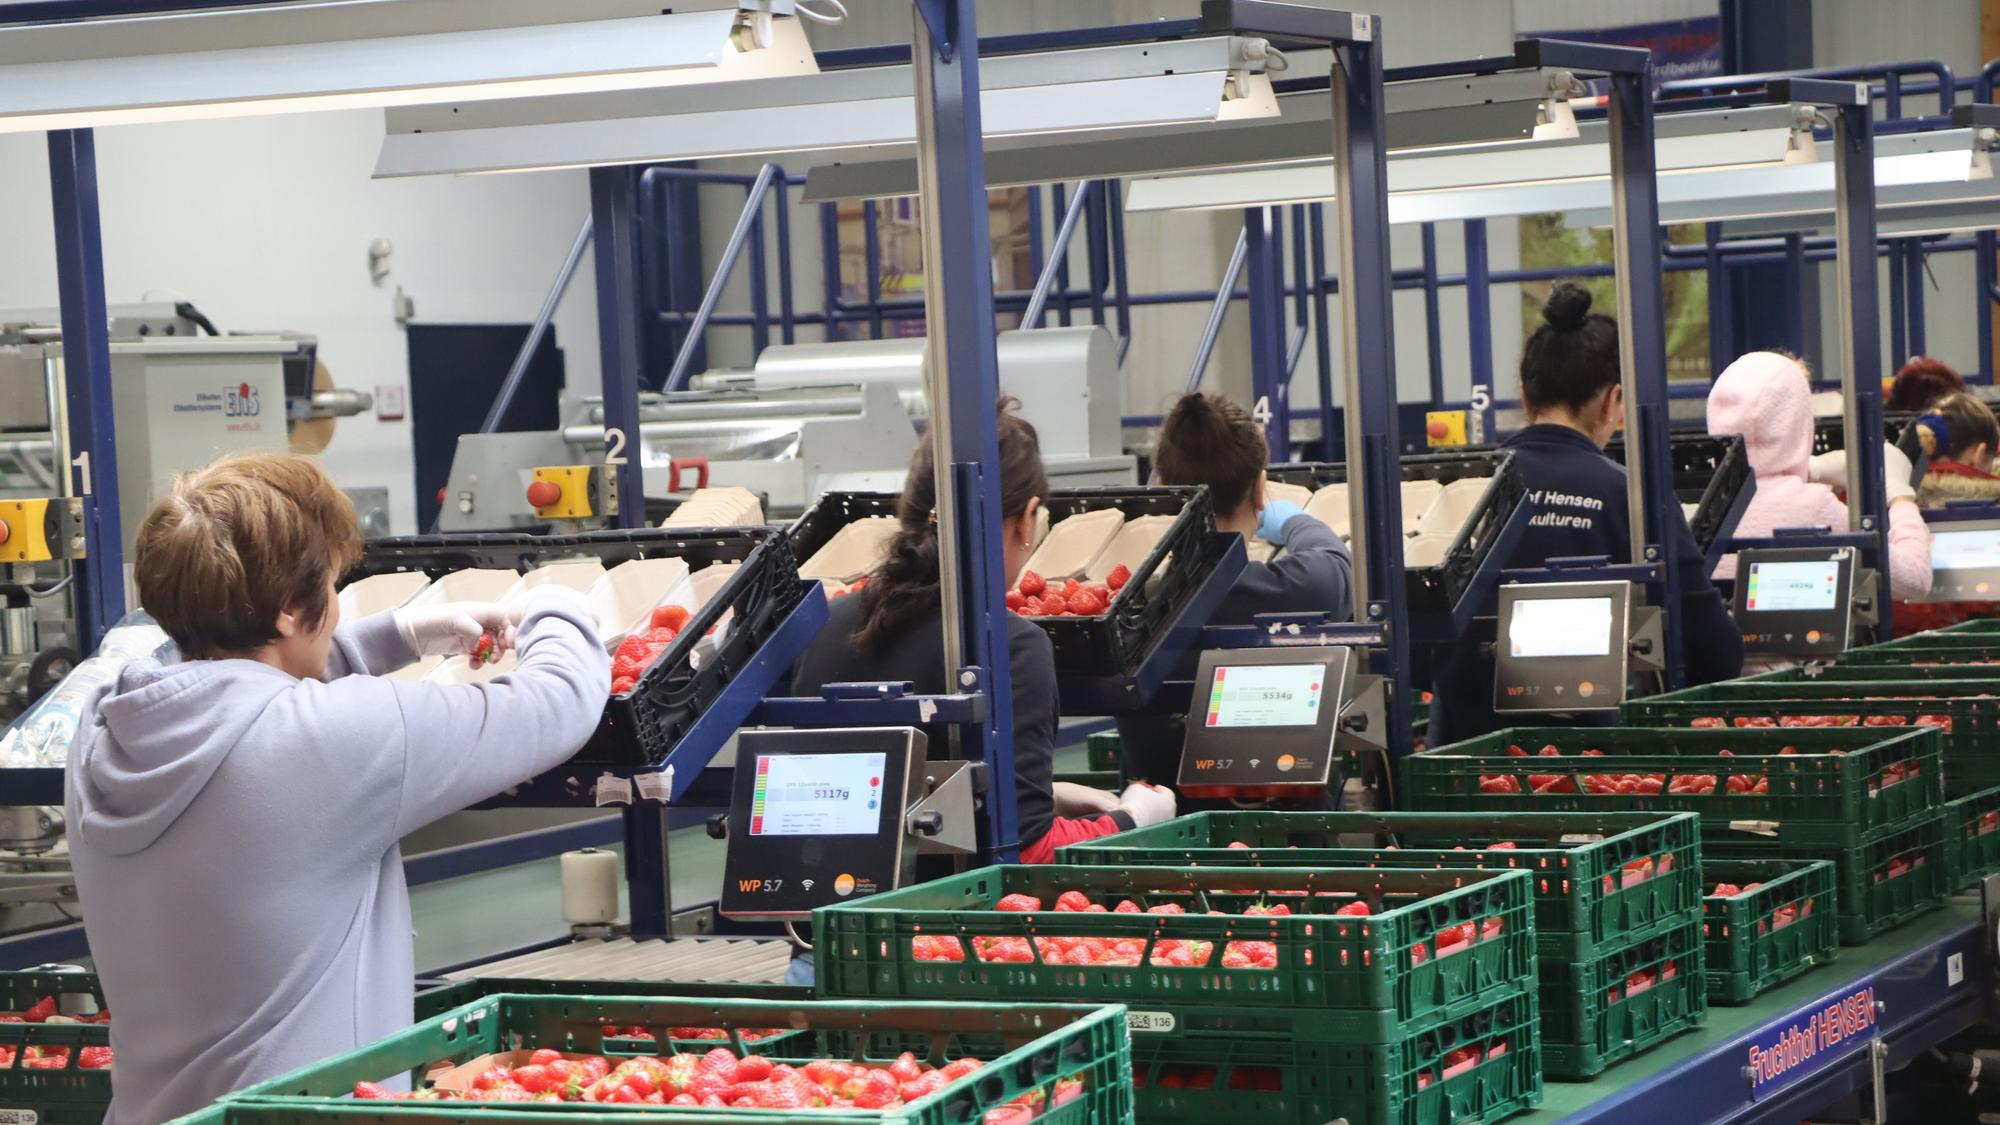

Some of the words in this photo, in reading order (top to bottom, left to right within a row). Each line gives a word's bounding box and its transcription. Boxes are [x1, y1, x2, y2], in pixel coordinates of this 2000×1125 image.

[1471, 384, 1490, 411] 5
[1252, 395, 1273, 424] 4
[604, 427, 628, 464] 2
[71, 450, 92, 495] 1
[1544, 490, 1604, 511] Hensen
[1507, 686, 1524, 696] WP
[1196, 759, 1215, 769] WP
[1217, 759, 1233, 769] 5.7
[814, 788, 850, 801] 5117g
[739, 879, 761, 892] WP
[763, 879, 782, 892] 5.7
[1154, 1017, 1171, 1027] 136
[1749, 1015, 1817, 1088] Fruchthof
[1818, 986, 1875, 1051] HENSEN
